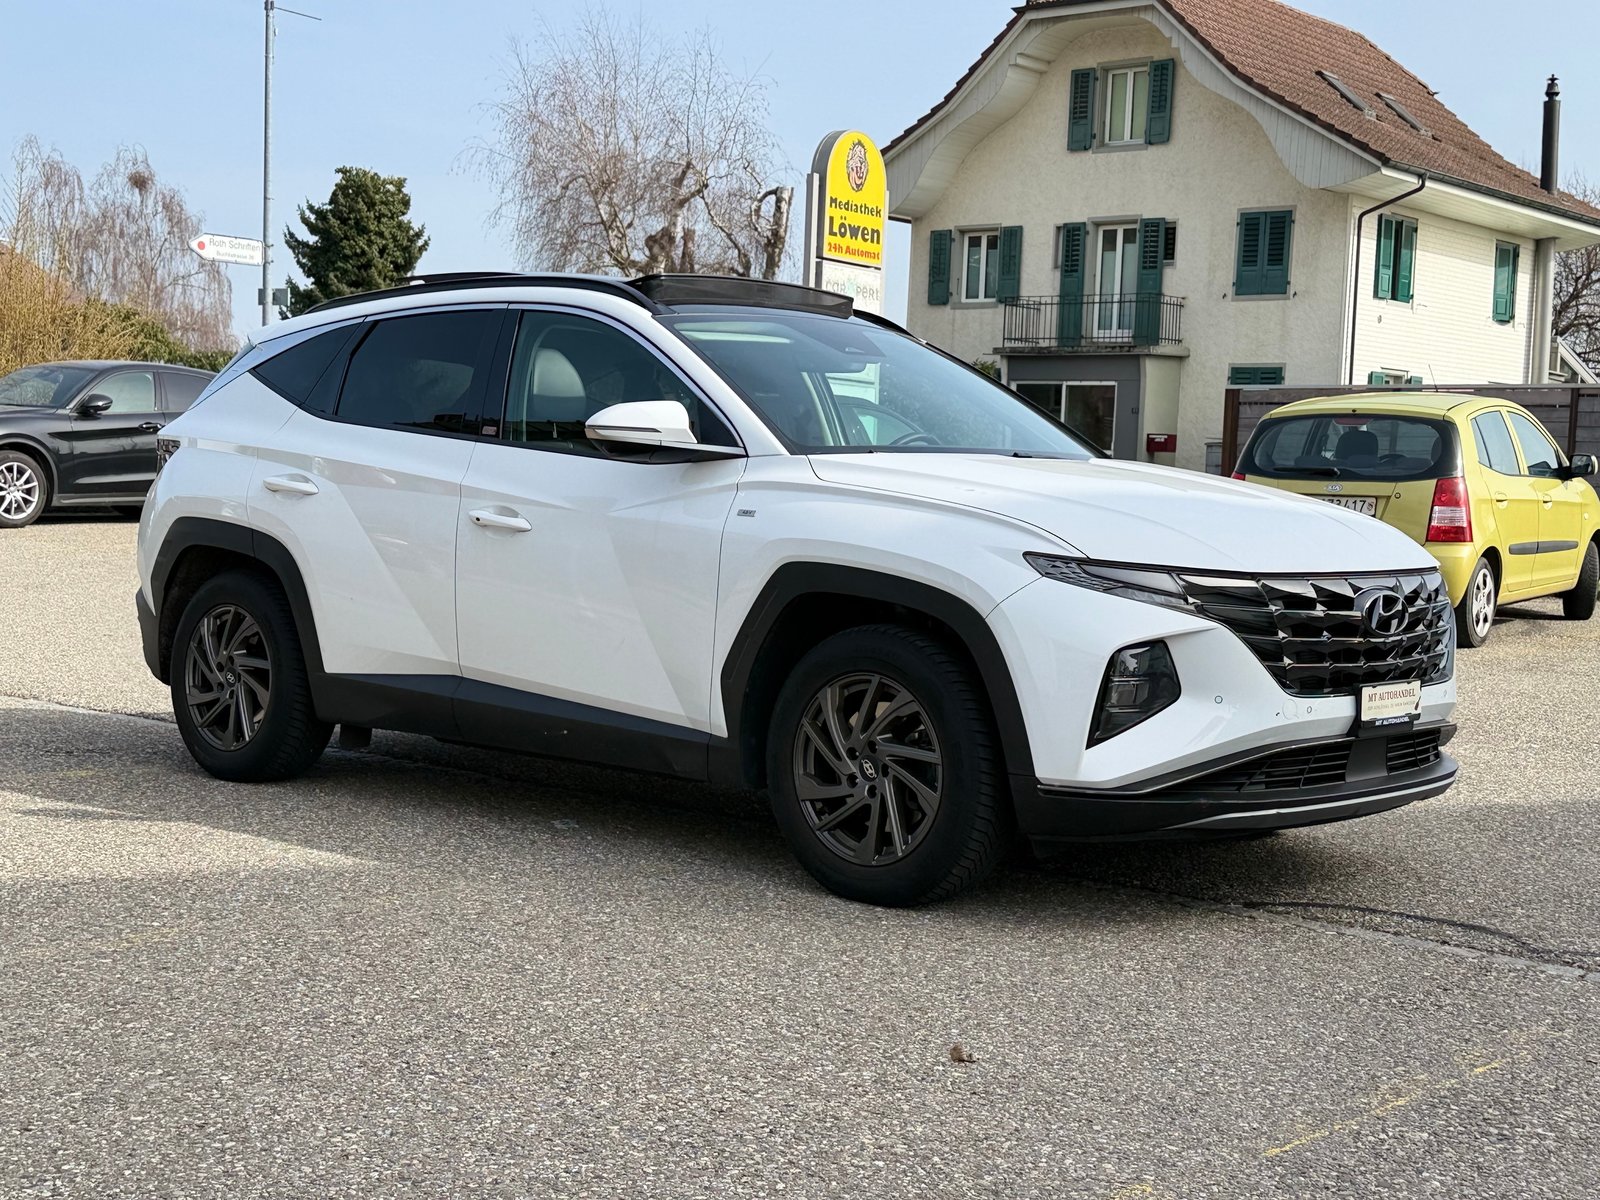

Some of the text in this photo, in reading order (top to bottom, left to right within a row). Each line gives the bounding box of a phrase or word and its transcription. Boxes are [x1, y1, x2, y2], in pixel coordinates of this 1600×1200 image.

[829, 196, 882, 218] Mediathek
[828, 215, 881, 245] Löwen
[209, 237, 226, 249] Roth
[827, 242, 880, 260] 24h Automat
[1368, 688, 1416, 703] MT AUTOHANDEL
